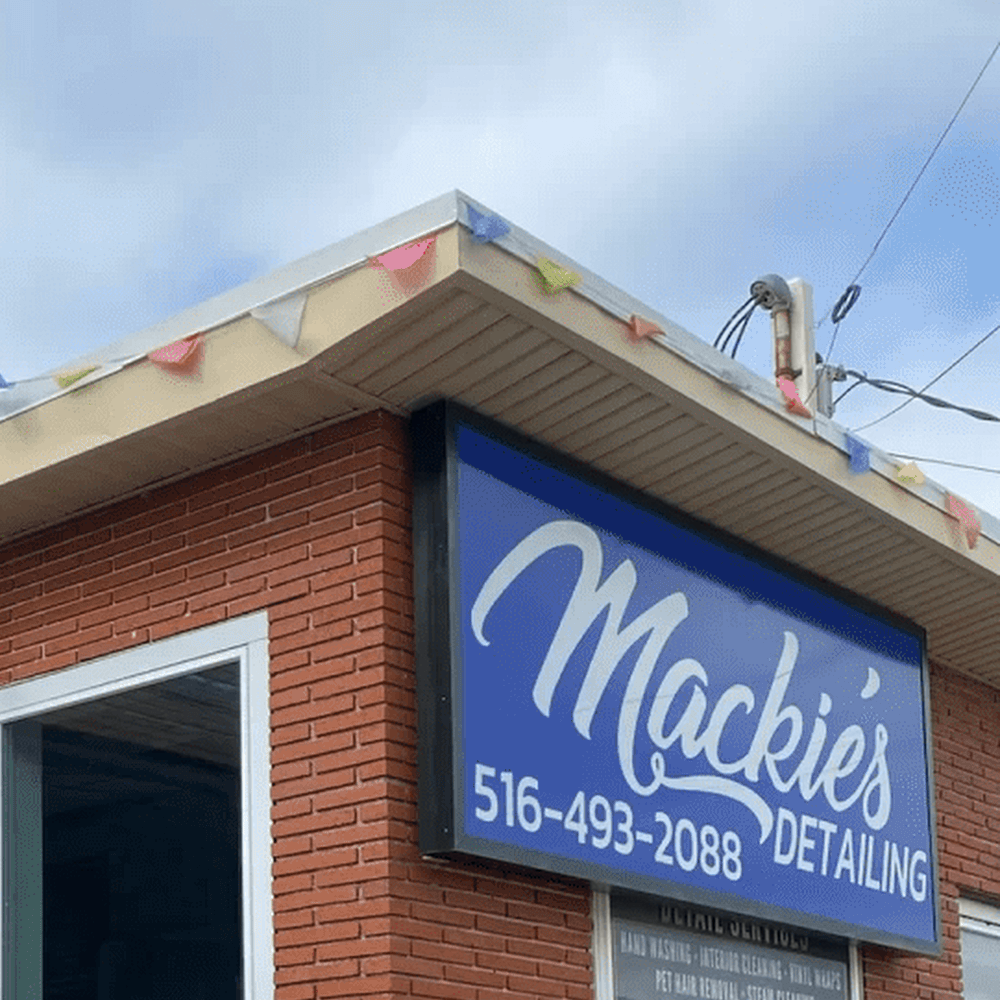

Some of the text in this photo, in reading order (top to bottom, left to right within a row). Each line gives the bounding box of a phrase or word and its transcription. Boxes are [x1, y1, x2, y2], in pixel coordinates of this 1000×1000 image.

[471, 519, 892, 845] Mackie's
[474, 762, 742, 882] 516-493-2088
[774, 807, 928, 902] DETAILING
[620, 930, 646, 957] HAND
[649, 936, 692, 965] WASHING
[655, 968, 672, 993] PET
